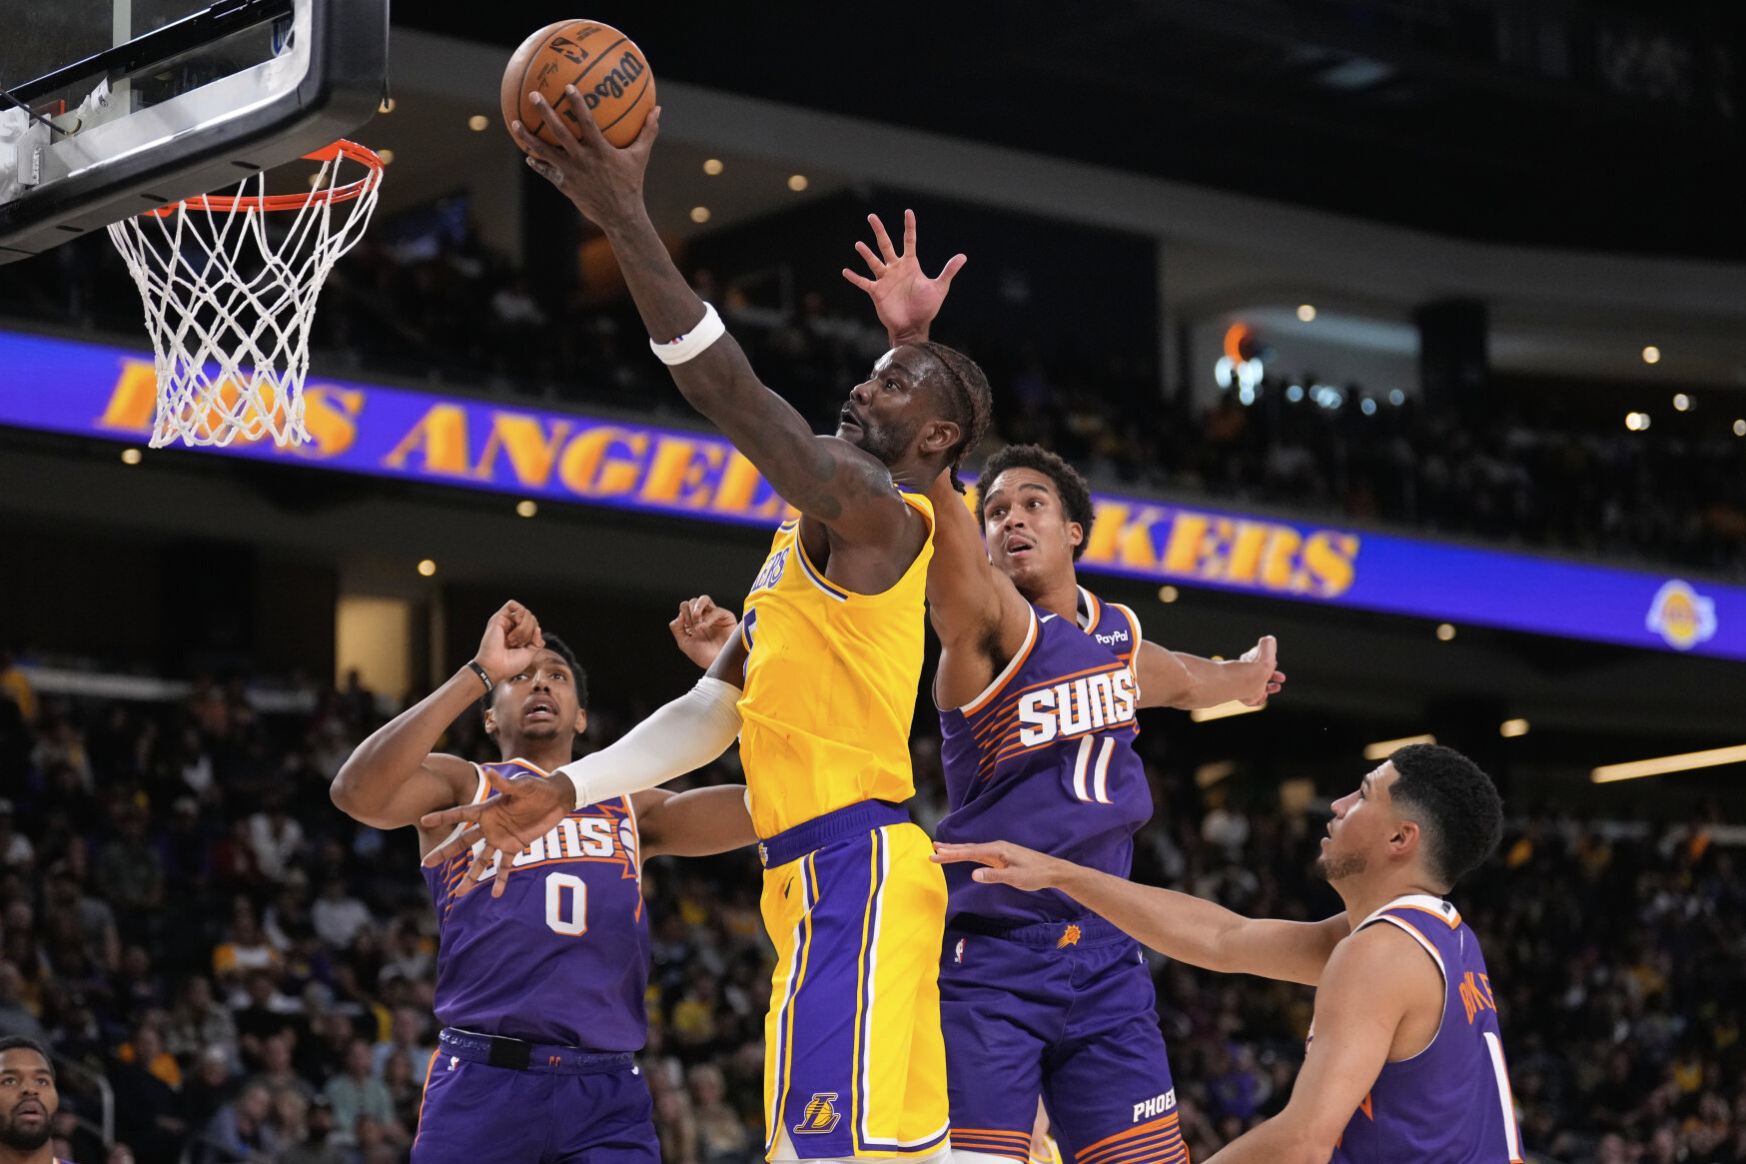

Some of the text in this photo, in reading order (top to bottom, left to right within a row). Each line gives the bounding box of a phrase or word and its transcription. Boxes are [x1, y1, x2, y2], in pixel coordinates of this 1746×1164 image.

[563, 51, 645, 123] Wilso
[96, 357, 366, 459] LOS
[380, 402, 801, 520] ANGEL
[1095, 630, 1129, 646] PayPal
[1018, 666, 1136, 747] SUNS
[1073, 734, 1115, 805] 11
[545, 871, 588, 937] 0
[1482, 1031, 1525, 1164] 1
